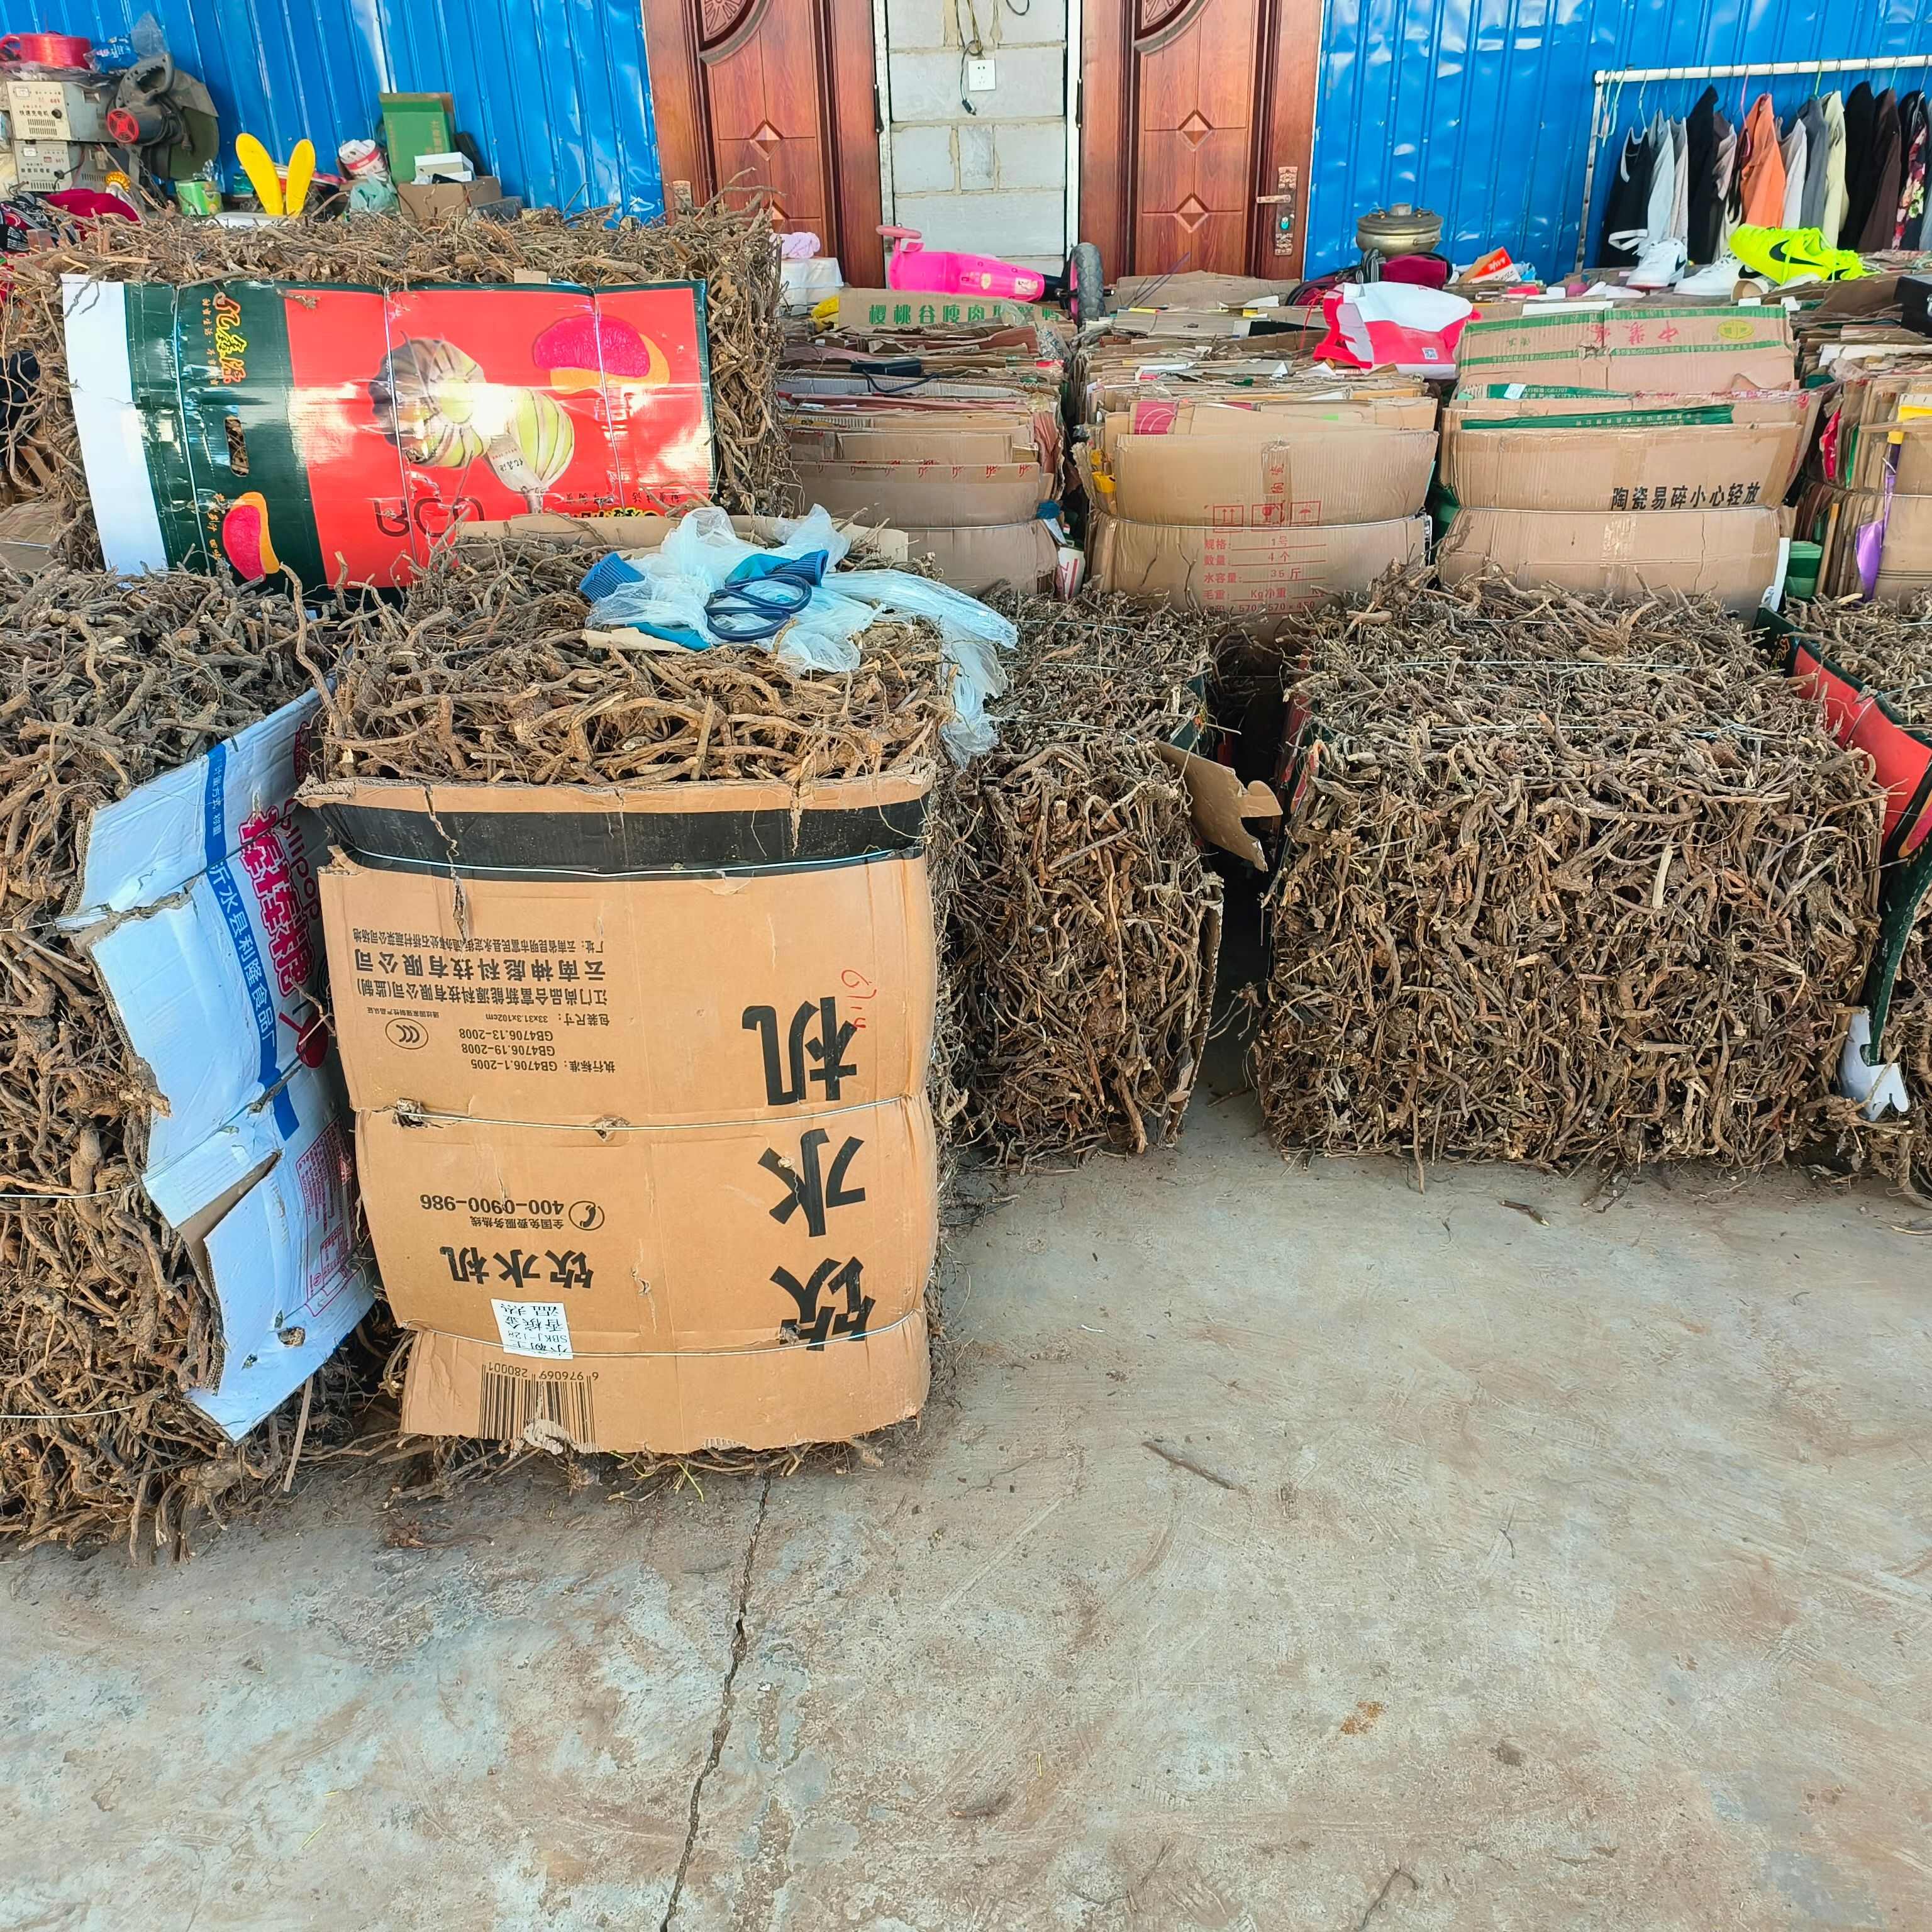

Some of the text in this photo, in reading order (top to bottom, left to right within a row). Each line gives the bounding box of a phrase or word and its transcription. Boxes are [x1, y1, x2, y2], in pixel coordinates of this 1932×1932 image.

[1611, 481, 1761, 511] 陶瓷易碎小心轻放
[209, 861, 275, 1048] 沂水县利隆食品厂
[354, 948, 606, 982] 云南神彪科技有限公司
[367, 1007, 440, 1019] 通过国家强制性产品认证
[458, 1028, 554, 1041] GB4706.13-2008
[461, 1045, 556, 1057] GB4706.19-2008
[470, 1059, 558, 1072] GB4706.1-2005
[741, 996, 876, 1352] 饮水机
[419, 1194, 564, 1215] 400-0900-986
[470, 1215, 564, 1230] 全国免费服务热线
[439, 1246, 594, 1289] 饮水机
[502, 1315, 564, 1332] 香槟金
[488, 1362, 528, 1378] 280001
[538, 1370, 584, 1381] 976069
